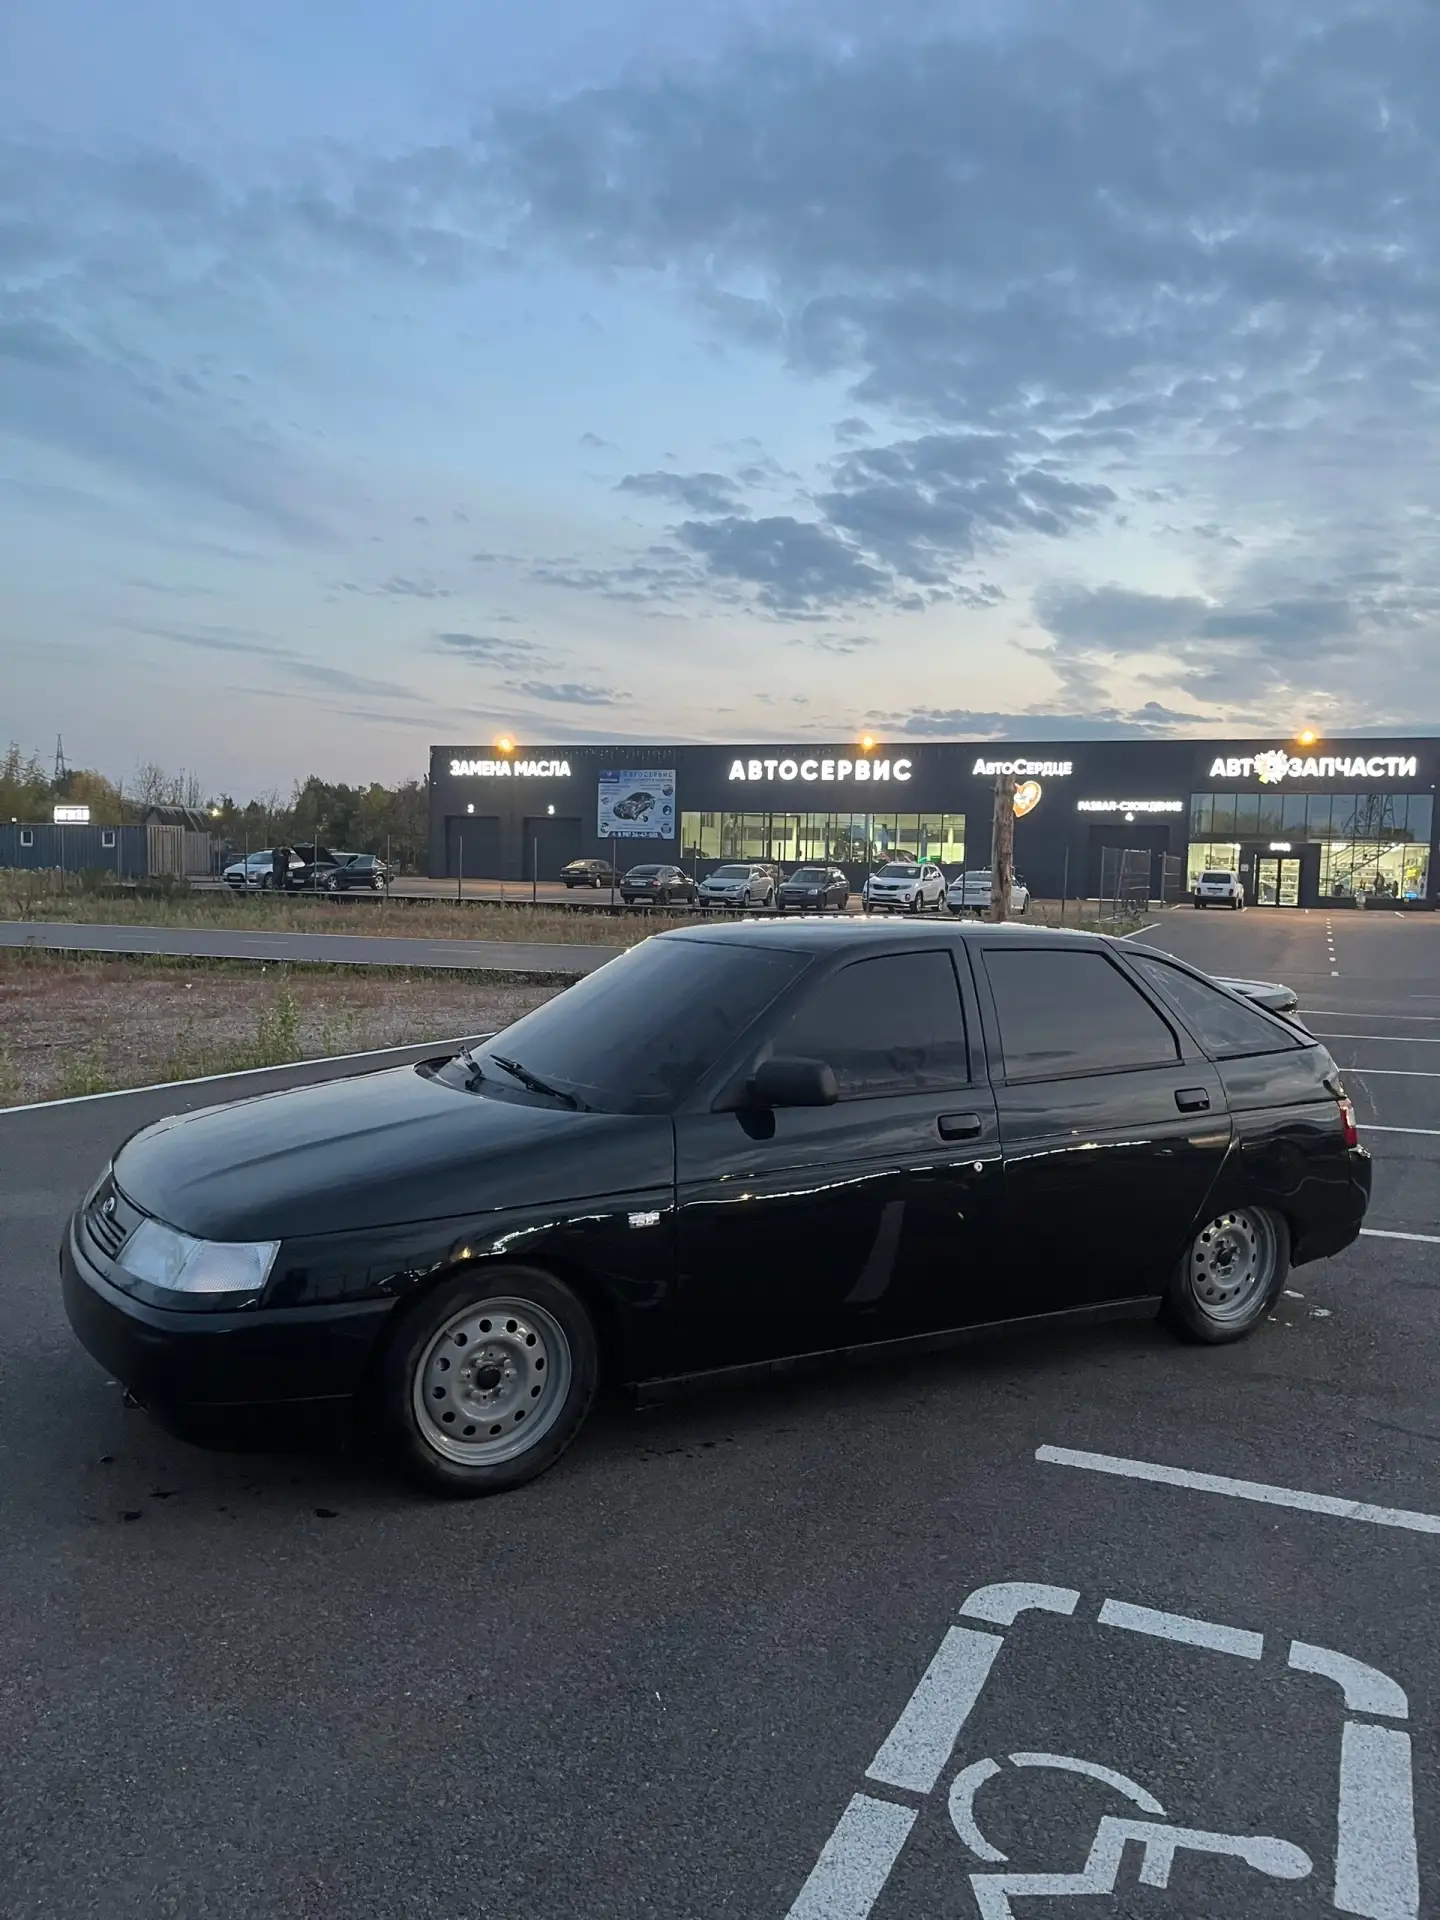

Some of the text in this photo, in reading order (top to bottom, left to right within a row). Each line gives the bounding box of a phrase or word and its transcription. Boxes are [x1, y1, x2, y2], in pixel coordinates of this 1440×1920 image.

[450, 760, 571, 777] ЗАМЕНА МАСЛА
[729, 759, 912, 781] АВТОСЕРВИС
